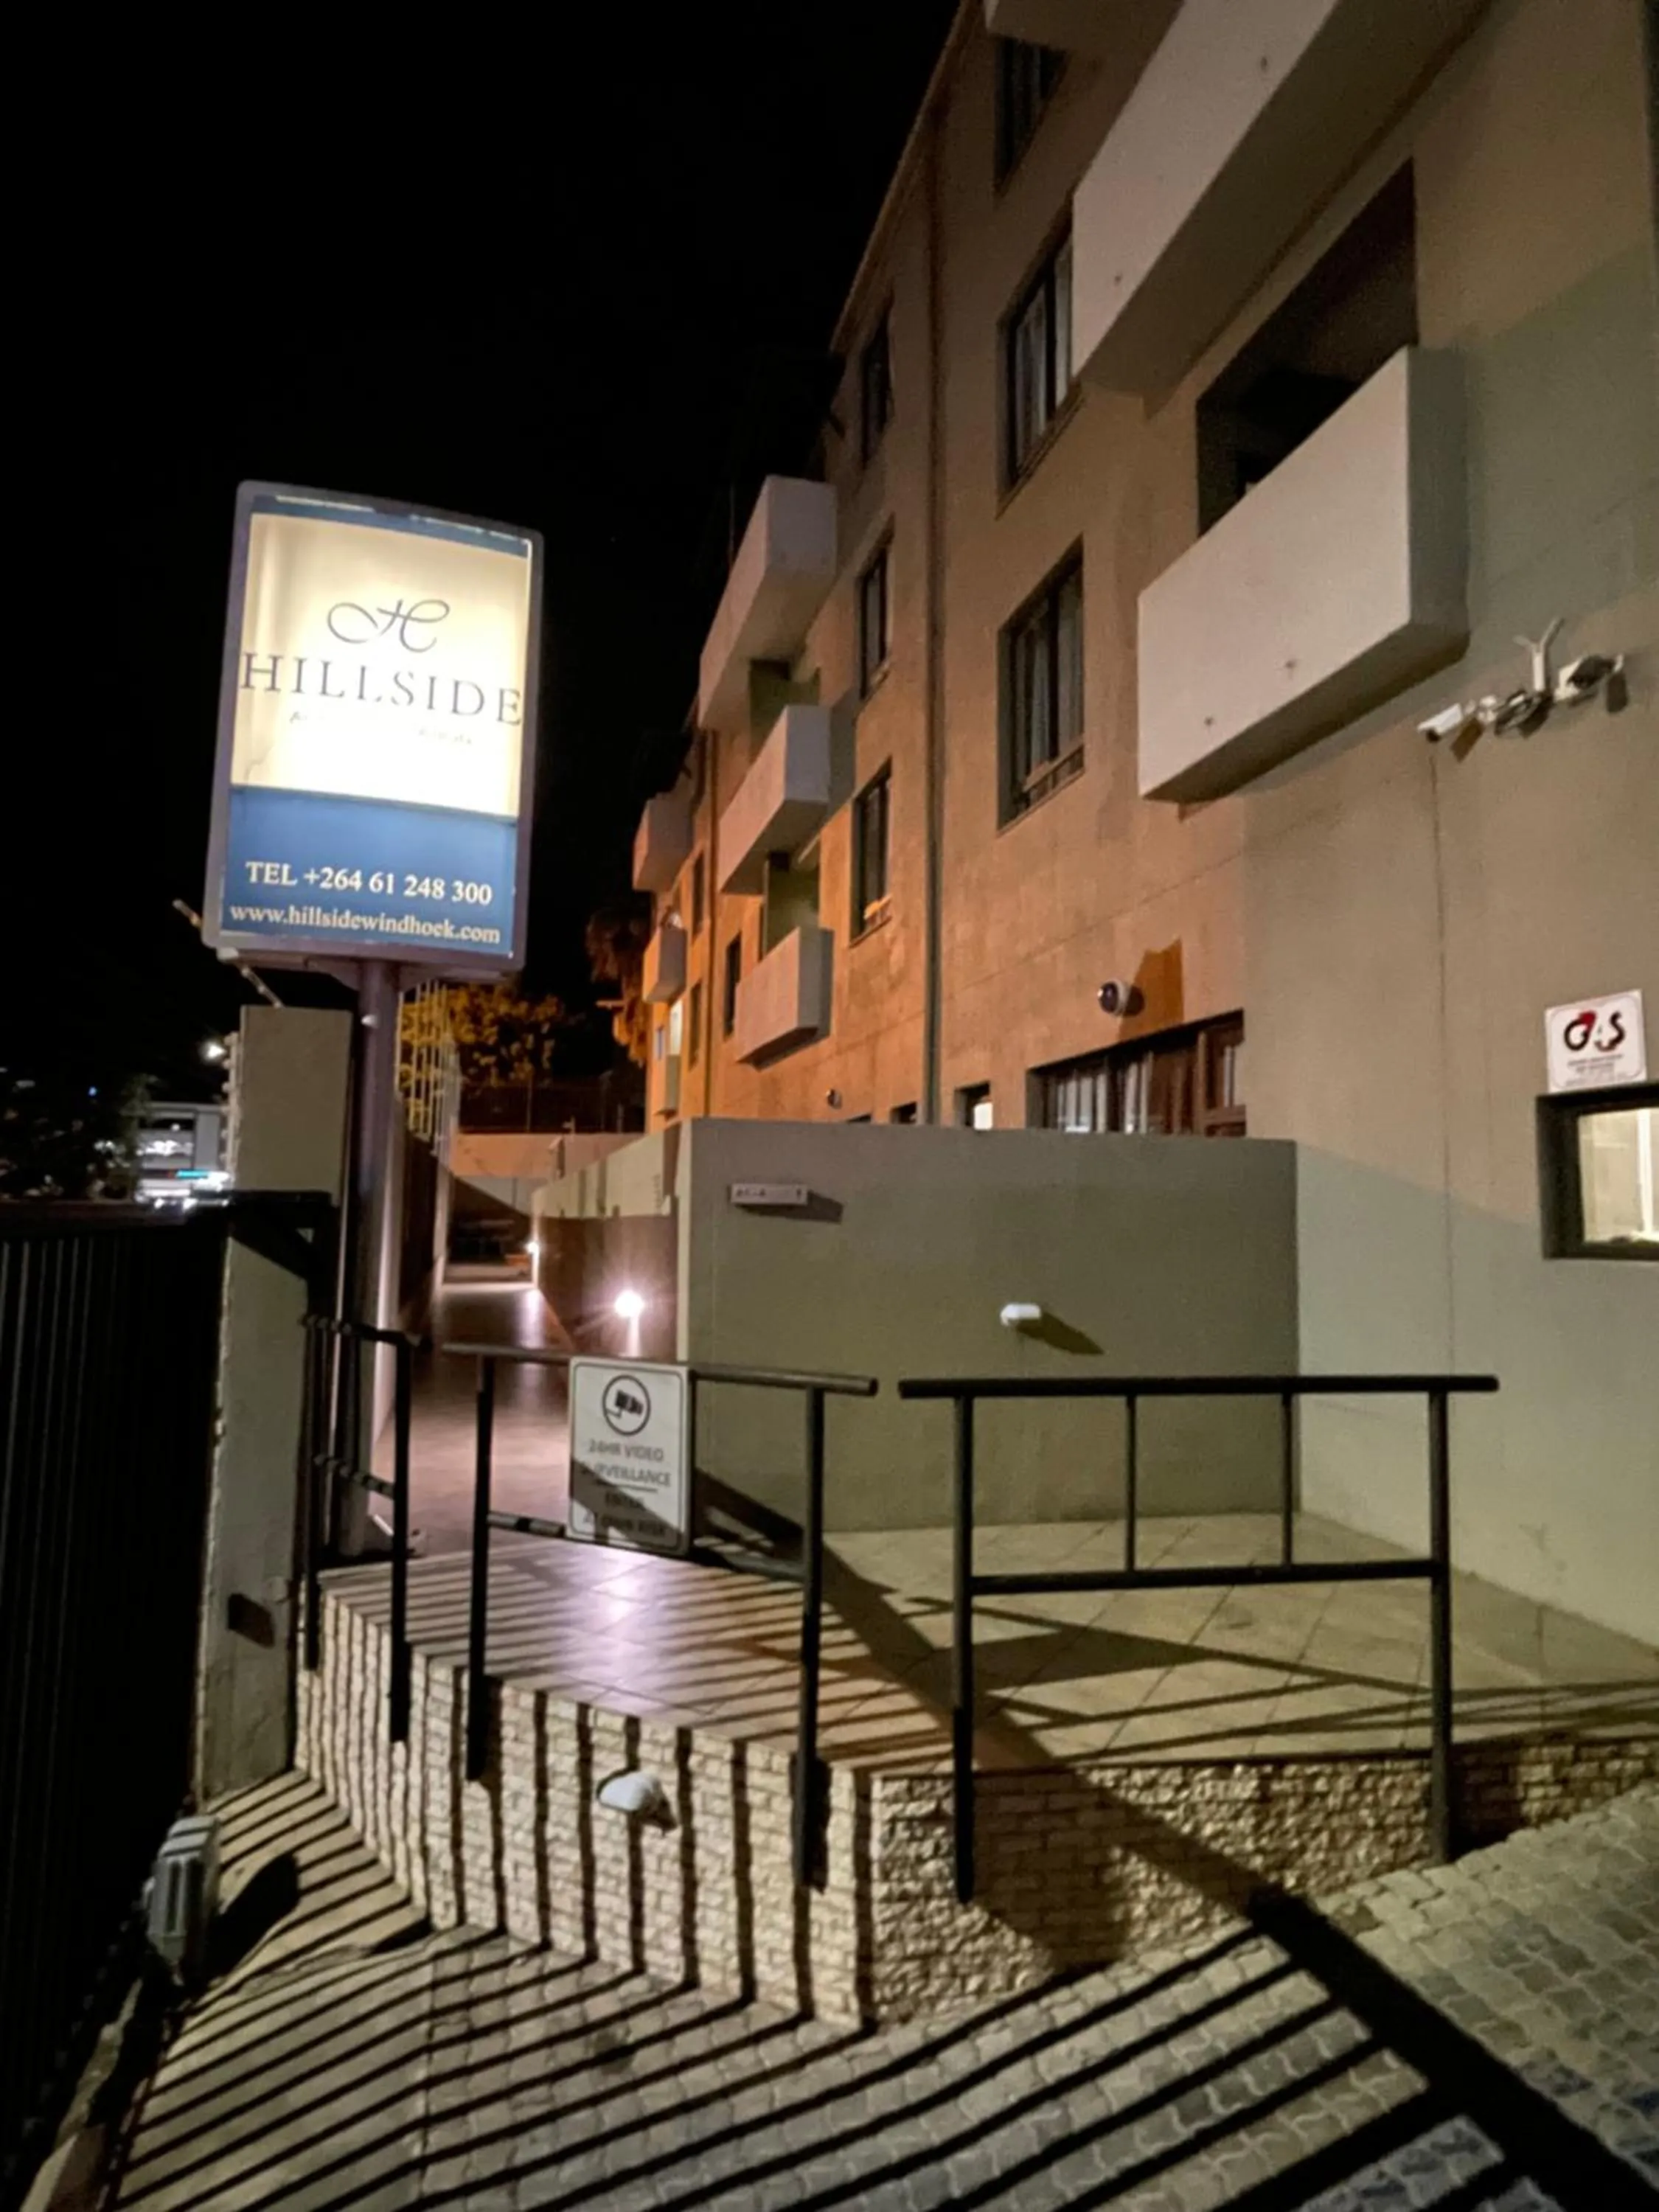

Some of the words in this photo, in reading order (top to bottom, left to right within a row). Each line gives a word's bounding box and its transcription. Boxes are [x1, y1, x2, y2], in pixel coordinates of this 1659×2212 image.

[240, 651, 523, 726] HILLSIDE
[245, 860, 298, 886] TEL
[303, 866, 363, 892] +264
[369, 871, 395, 895] 61
[403, 874, 445, 900] 248
[451, 880, 493, 906] 300
[229, 904, 501, 945] www.hillsidewindhoek.com
[624, 1444, 665, 1463] VIDEO
